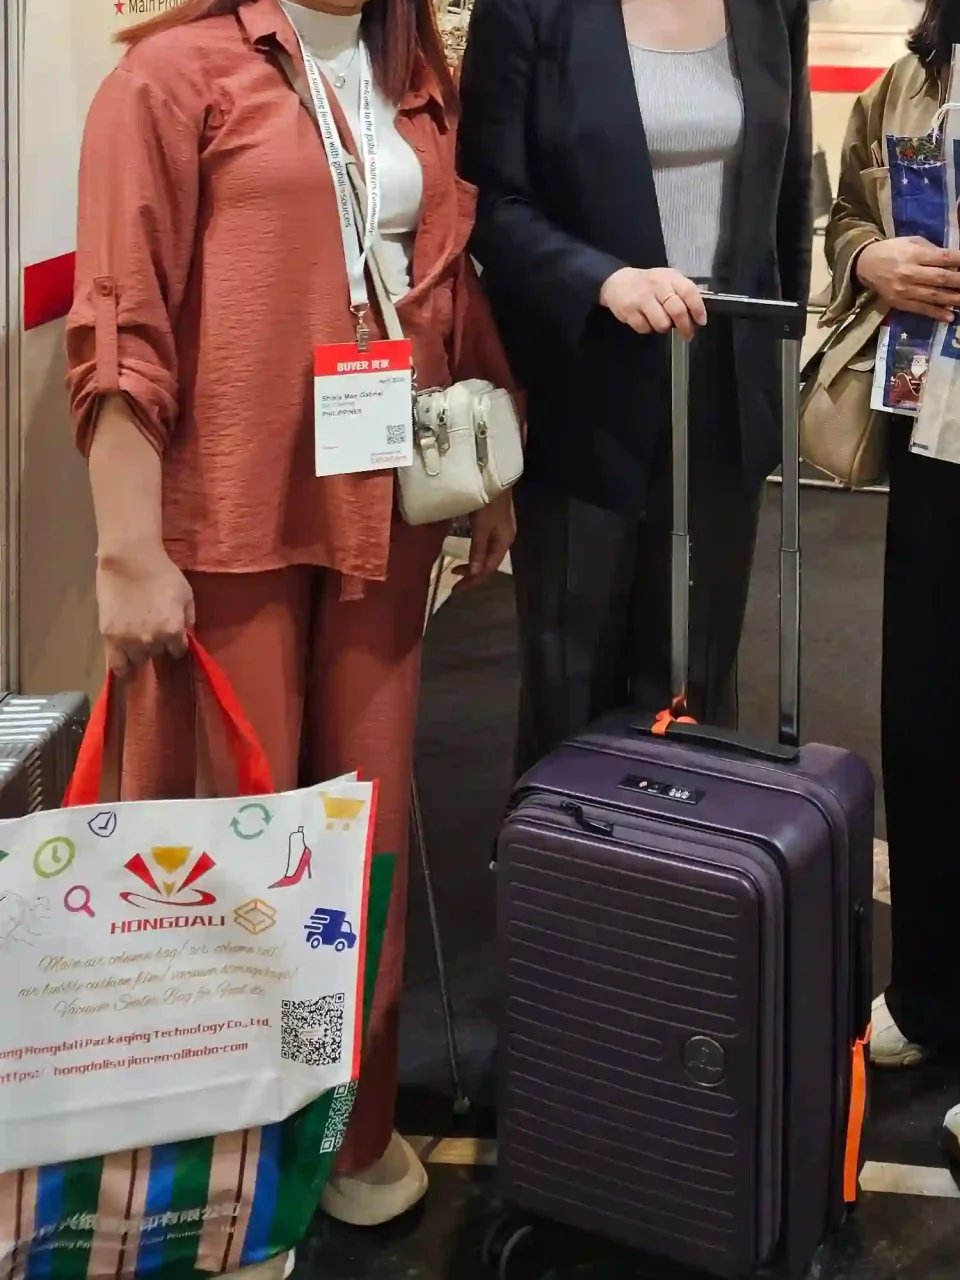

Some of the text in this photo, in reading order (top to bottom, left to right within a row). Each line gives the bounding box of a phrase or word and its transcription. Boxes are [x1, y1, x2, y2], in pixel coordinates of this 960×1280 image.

[336, 360, 369, 372] BUYER
[109, 915, 226, 935] HONGDALI
[84, 1032, 152, 1047] Packaging
[153, 1022, 226, 1040] Technology
